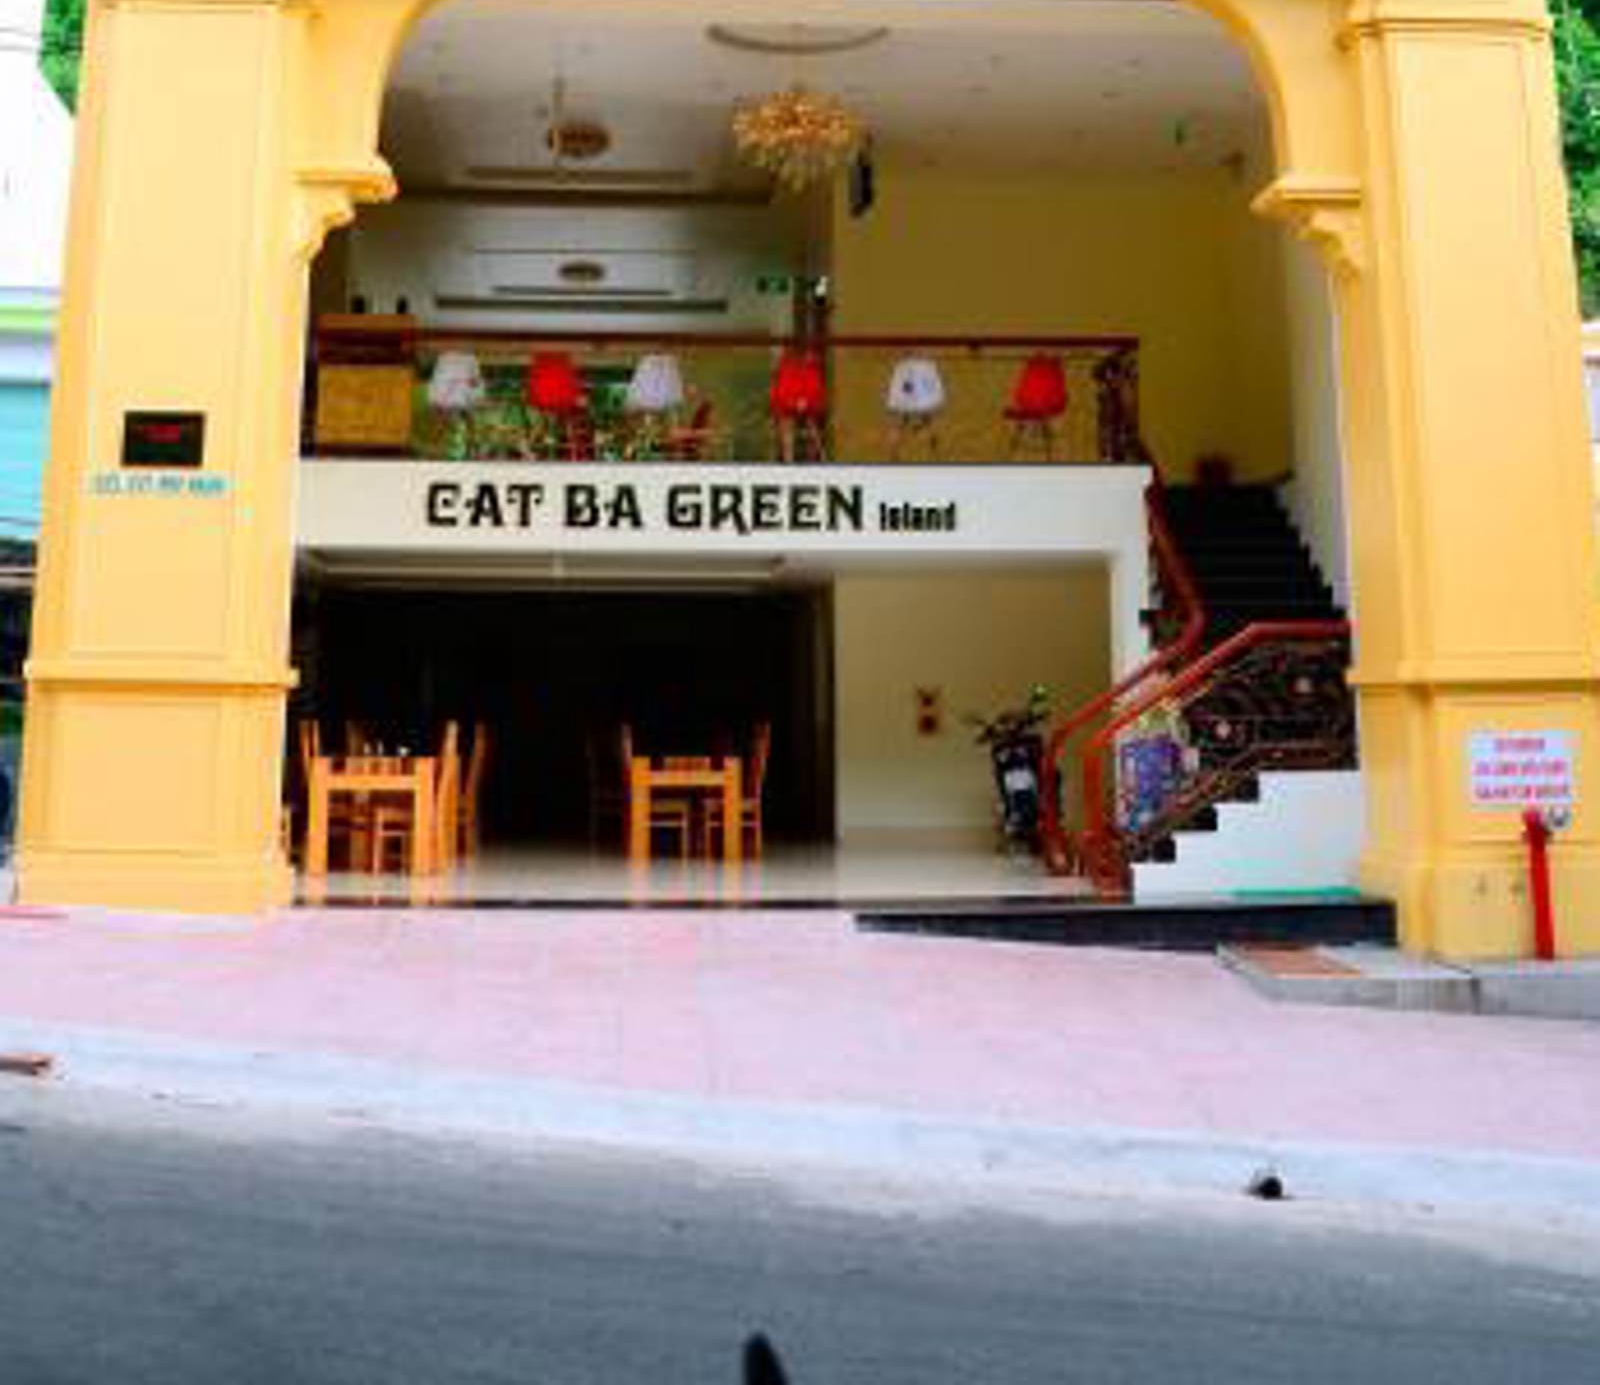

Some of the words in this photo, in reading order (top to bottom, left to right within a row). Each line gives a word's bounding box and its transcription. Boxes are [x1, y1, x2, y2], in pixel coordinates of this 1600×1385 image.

[427, 483, 542, 529] CAT
[563, 483, 643, 529] BA
[666, 484, 864, 535] GREEN
[878, 501, 957, 532] Island
